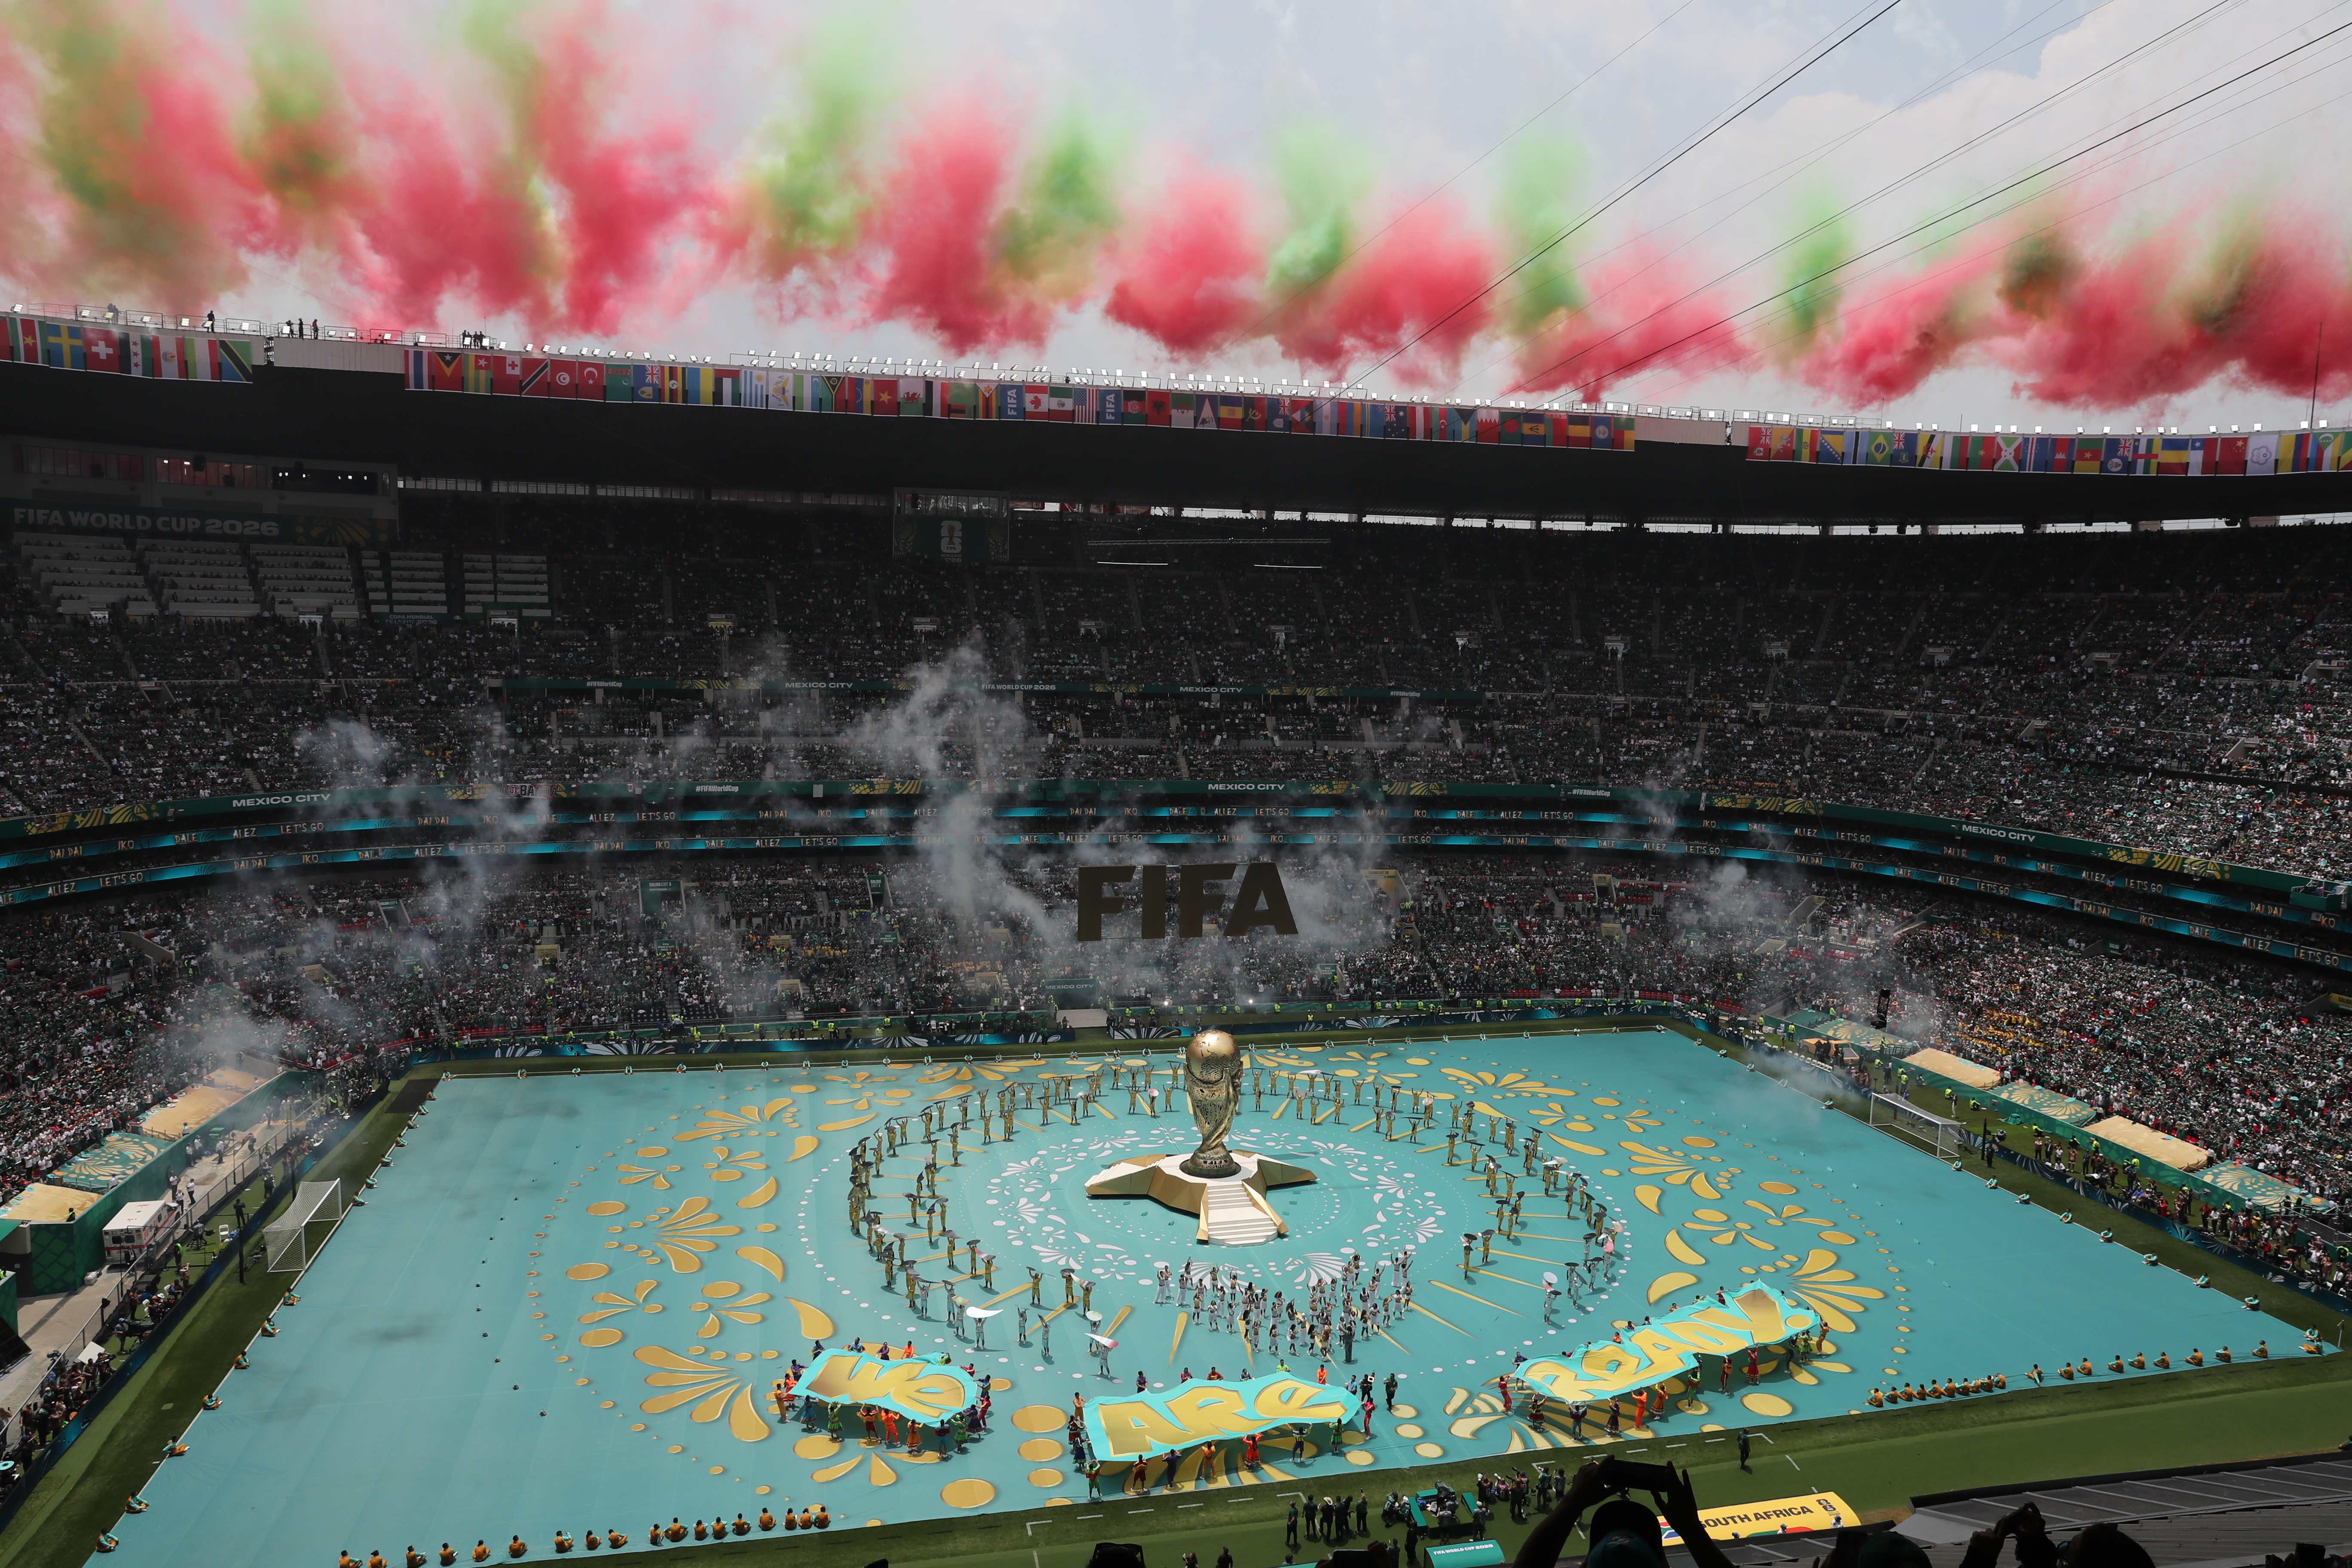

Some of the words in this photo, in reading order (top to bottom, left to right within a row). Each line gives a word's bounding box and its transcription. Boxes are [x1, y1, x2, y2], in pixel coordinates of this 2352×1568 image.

[1007, 389, 1017, 415] FIFA
[1106, 393, 1115, 420] FIFA
[14, 508, 64, 526] FIFA
[69, 511, 151, 530] WORLD
[156, 516, 201, 533] CUP
[205, 519, 279, 536] 2026
[695, 785, 739, 793] #FIFAWorldCup
[1572, 789, 1611, 797] #FIFAWorldCup
[233, 795, 292, 807] MEXICO
[296, 794, 331, 802] CITY
[417, 817, 432, 825] DAI
[435, 816, 449, 824] DAI
[483, 816, 498, 824] IKO
[589, 813, 615, 823] ALLEZ
[637, 812, 661, 821] LET'S
[759, 810, 772, 819] DAI
[774, 810, 787, 818] DAI
[1214, 808, 1237, 816] ALLEZ
[1256, 808, 1276, 816] LET'S
[50, 848, 64, 859] DAI
[68, 845, 82, 856] DAI
[118, 840, 134, 850] IKO
[175, 833, 197, 844] DALE
[281, 824, 307, 835] LET'S
[310, 822, 324, 832] GO
[1066, 835, 1089, 843] ALLEZ
[1109, 834, 1130, 842] LET'S
[1703, 820, 1716, 828] IKO
[1749, 824, 1766, 832] DALE
[1794, 827, 1817, 837] ALLEZ
[1837, 831, 1858, 842] LET'S
[1860, 834, 1871, 843] GO
[1962, 824, 2006, 838] MEXICO
[2008, 831, 2036, 842] CITY
[610, 842, 624, 850] DAI
[655, 841, 670, 849] IKO
[705, 840, 725, 848] DALE
[756, 839, 781, 848] ALLEZ
[801, 838, 824, 847] LET'S
[826, 837, 838, 846] GO
[1599, 840, 1616, 849] DALE
[1643, 843, 1666, 851] ALLEZ
[1685, 845, 1707, 854] LET'S
[1709, 847, 1720, 855] GO
[234, 860, 248, 870] DAI
[252, 858, 266, 867] DAI
[302, 854, 318, 863] IKO
[415, 847, 441, 858] ALLEZ
[465, 845, 490, 854] LET'S
[493, 845, 506, 853] GO
[1797, 855, 1809, 864] DAI
[1811, 857, 1823, 866] DAI
[1850, 861, 1864, 870] IKO
[1895, 868, 1912, 878] DALE
[1938, 875, 1960, 887] ALLEZ
[1978, 882, 1997, 894] LET'S
[1999, 886, 2009, 895] GO
[1994, 854, 2006, 864] IKO
[2037, 862, 2055, 873] DALE
[2082, 871, 2106, 882] ALLEZ
[2125, 878, 2147, 891] LET'S
[2150, 884, 2162, 893] GO
[48, 882, 76, 897] ALLEZ
[100, 874, 126, 888] LET'S
[130, 873, 143, 883] GO
[1078, 862, 1298, 941] FIFA
[2250, 902, 2265, 914] DAI
[2267, 905, 2283, 917] DAI
[2083, 903, 2095, 914] DAI
[2098, 906, 2110, 917] DAI
[2140, 915, 2154, 926] IKO
[2190, 926, 2210, 939] DALE
[2242, 937, 2271, 952] ALLEZ
[2294, 948, 2321, 963] LET'S
[2324, 955, 2339, 966] GO
[1753, 1506, 1814, 1521] AFRICA
